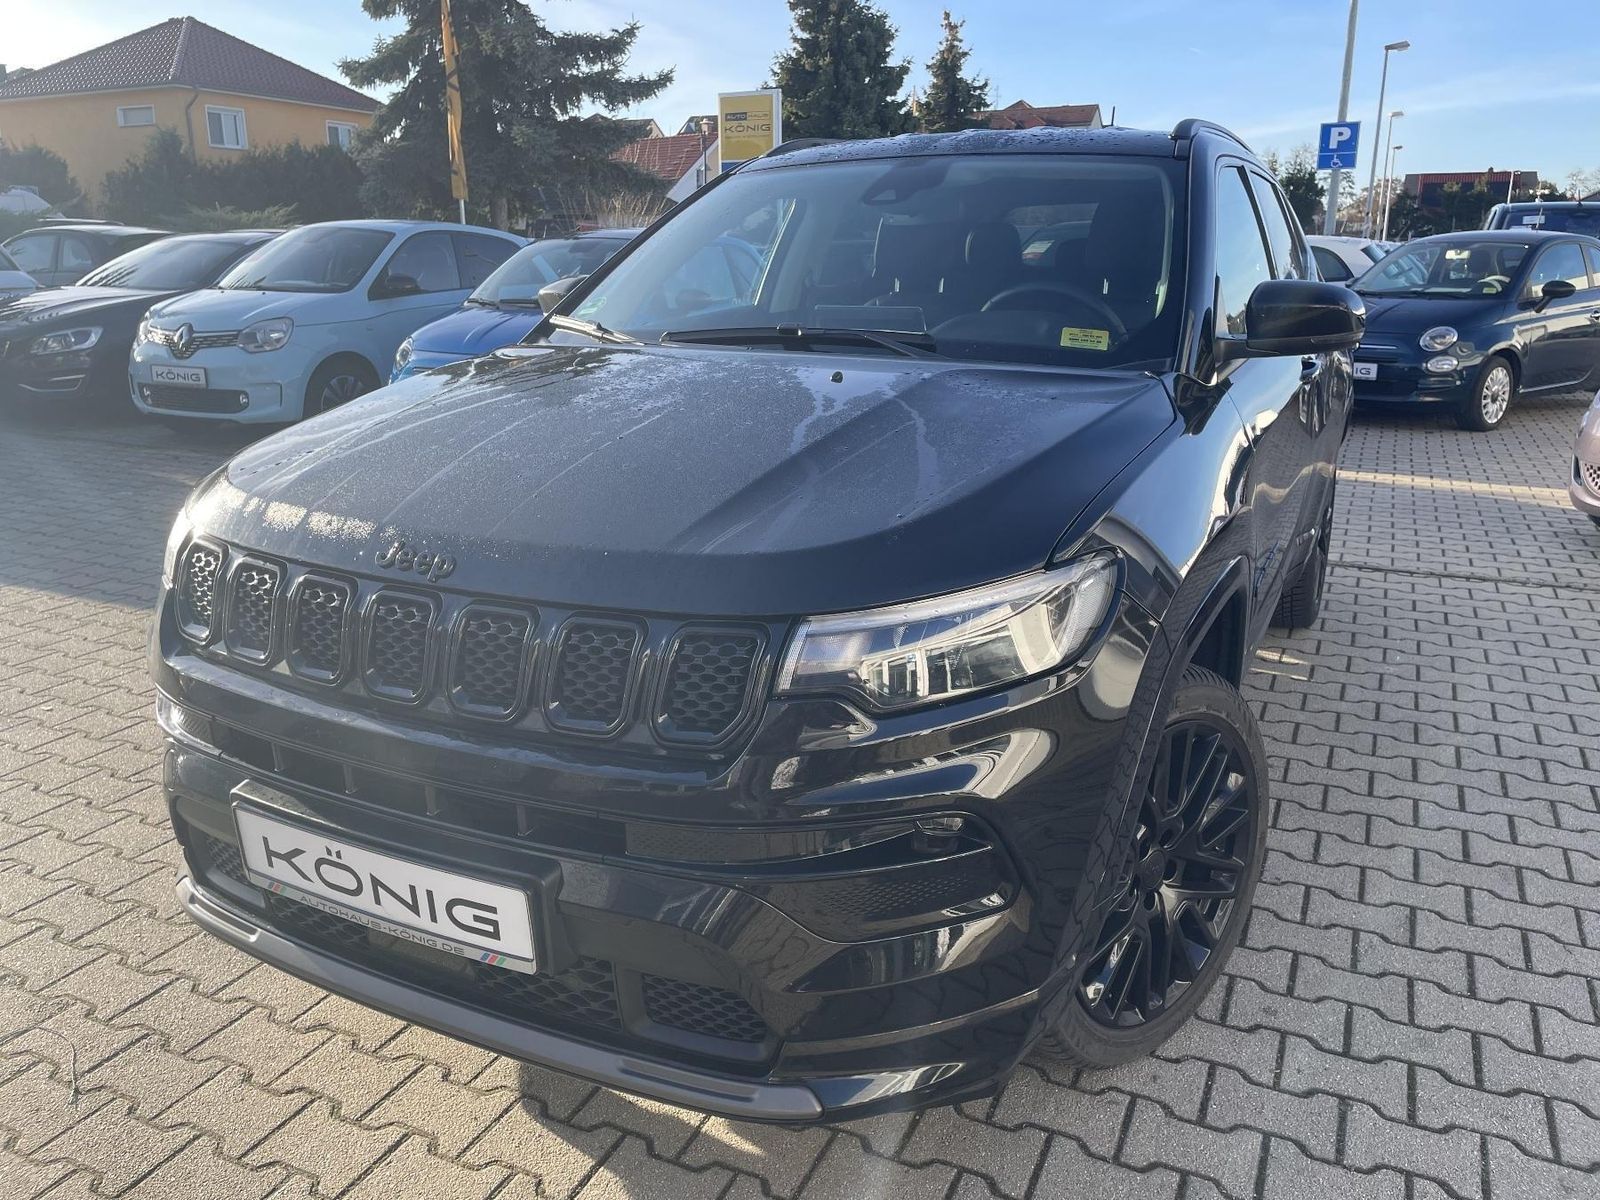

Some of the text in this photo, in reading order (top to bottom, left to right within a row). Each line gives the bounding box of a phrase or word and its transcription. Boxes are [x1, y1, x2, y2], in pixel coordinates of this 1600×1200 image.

[725, 122, 772, 133] KÖNIG
[1329, 126, 1352, 149] P
[156, 368, 201, 382] KÖNIG
[375, 540, 457, 583] Jeep
[262, 835, 501, 941] KÖNIG
